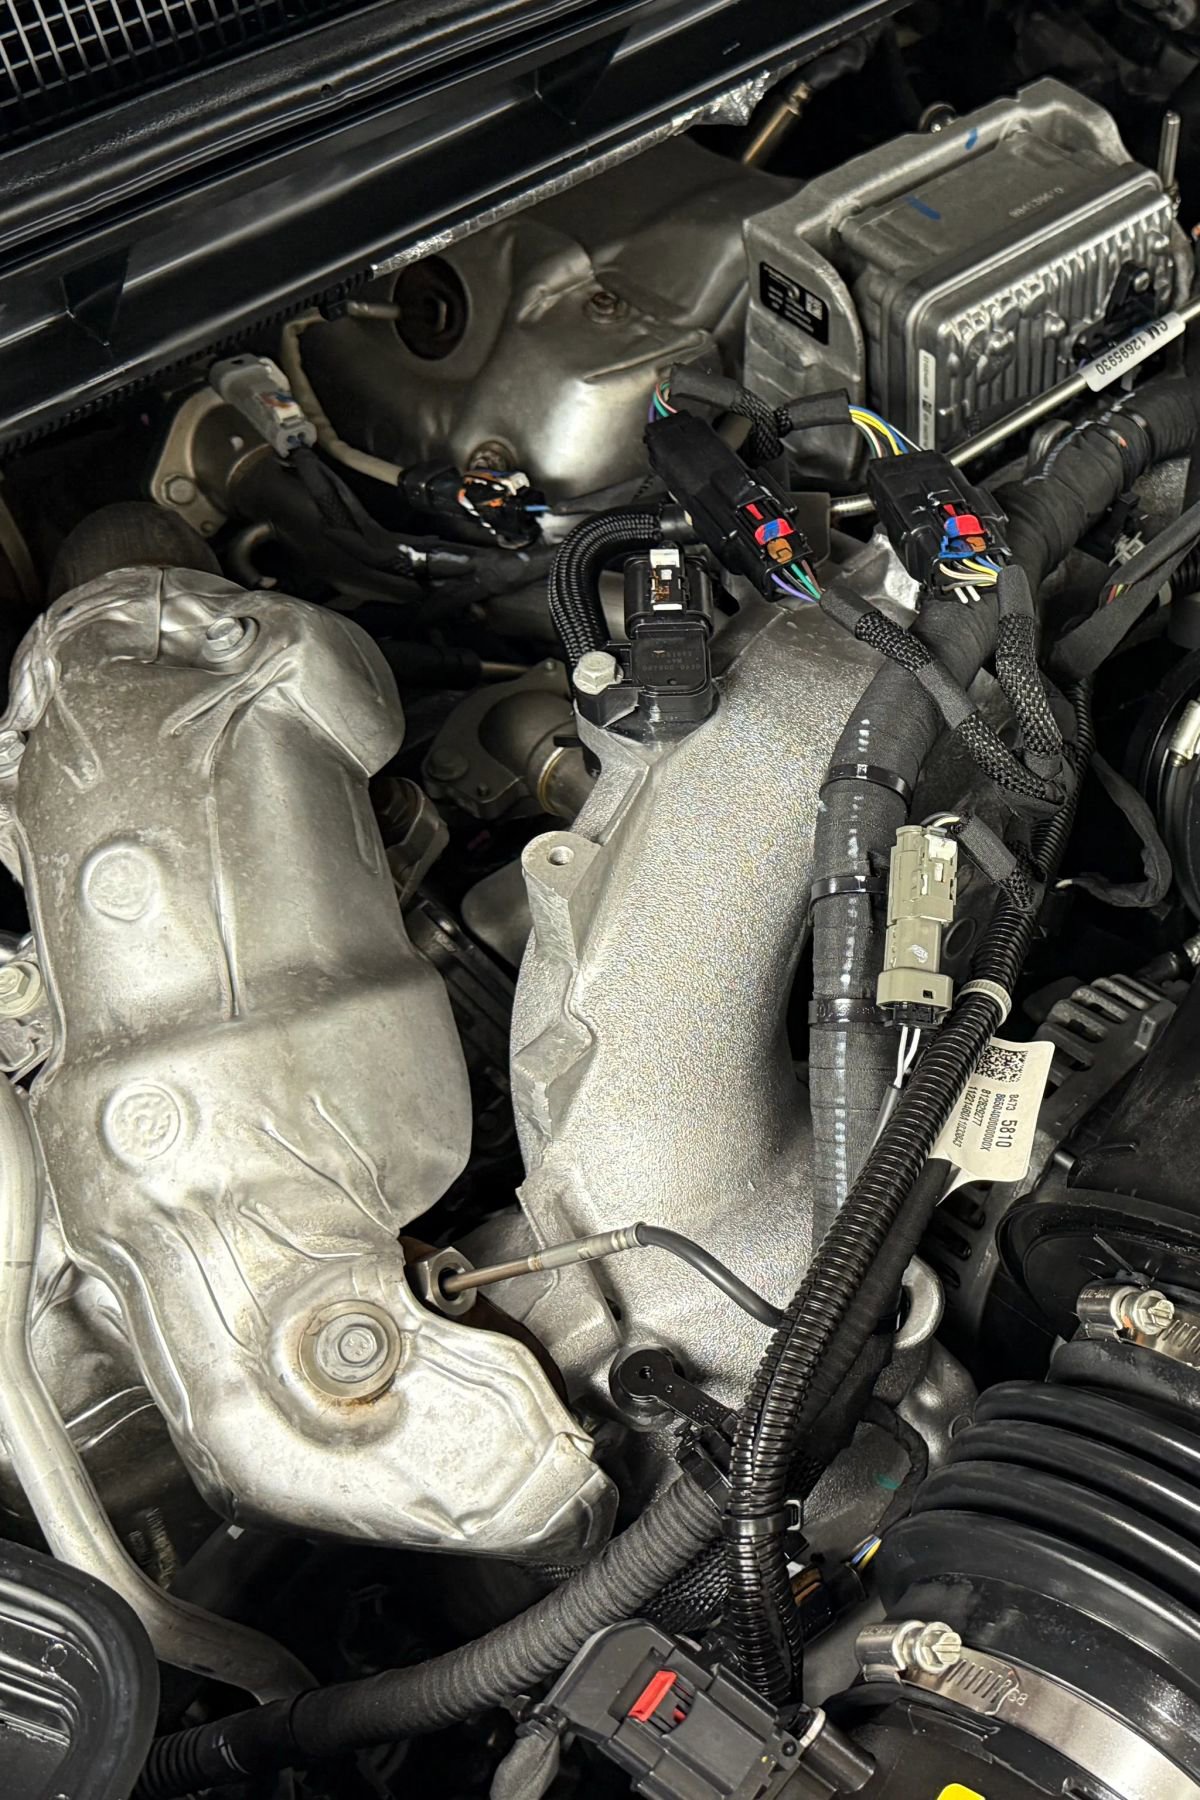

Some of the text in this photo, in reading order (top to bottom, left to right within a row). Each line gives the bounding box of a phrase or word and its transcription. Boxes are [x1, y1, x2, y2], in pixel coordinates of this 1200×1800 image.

[1095, 320, 1168, 375] GM 12695930
[995, 1120, 1018, 1148] 5810
